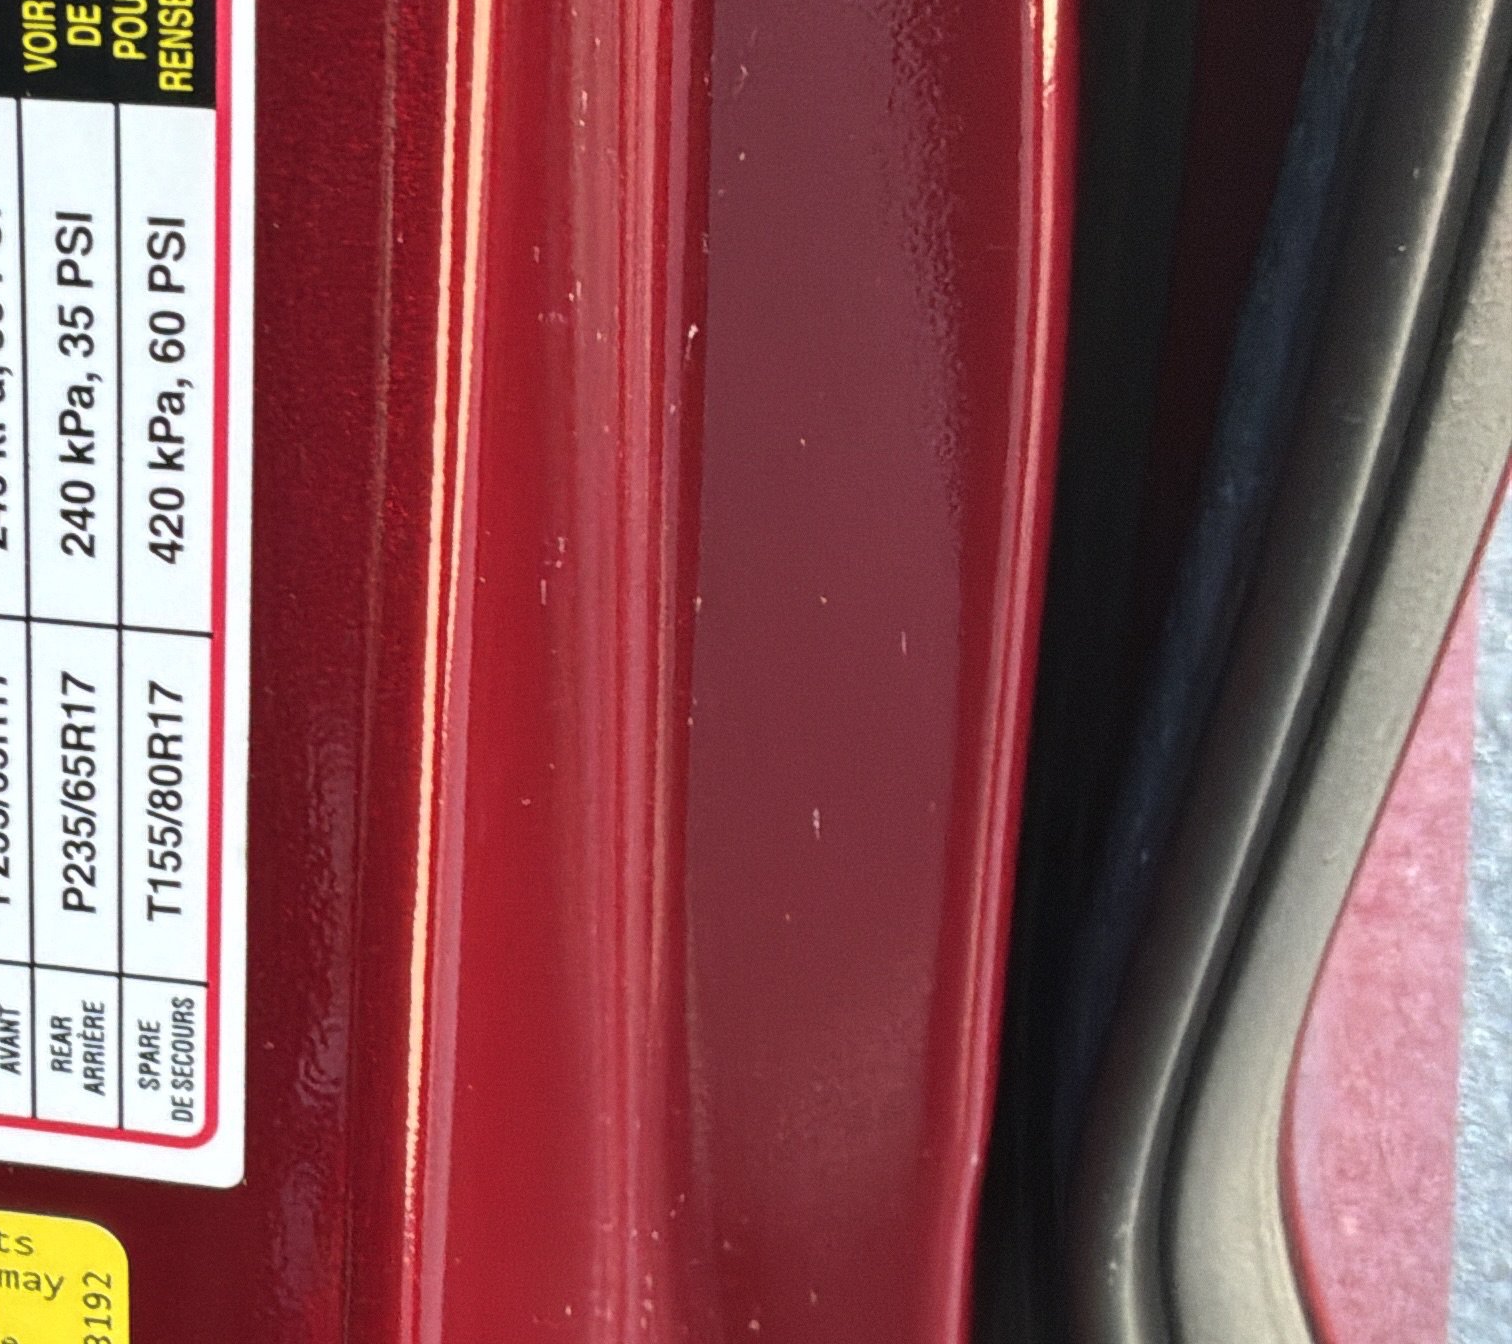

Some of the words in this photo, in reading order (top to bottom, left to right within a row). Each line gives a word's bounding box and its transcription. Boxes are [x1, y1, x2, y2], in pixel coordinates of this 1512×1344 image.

[65, 2, 102, 47] DE
[53, 209, 94, 288] PSI
[145, 215, 186, 294] PSI
[56, 303, 95, 358] 35
[147, 308, 186, 364] 60
[57, 371, 103, 465] kPa,
[146, 377, 193, 472] kPa,
[58, 478, 96, 558] 240
[147, 485, 186, 565] 420
[59, 669, 97, 914] P235/65R17
[145, 679, 184, 922] T155/80R17
[49, 1014, 73, 1074] REAR
[136, 1019, 161, 1091] SPARE
[169, 995, 196, 1092] SECOURS
[169, 1094, 195, 1123] DE
